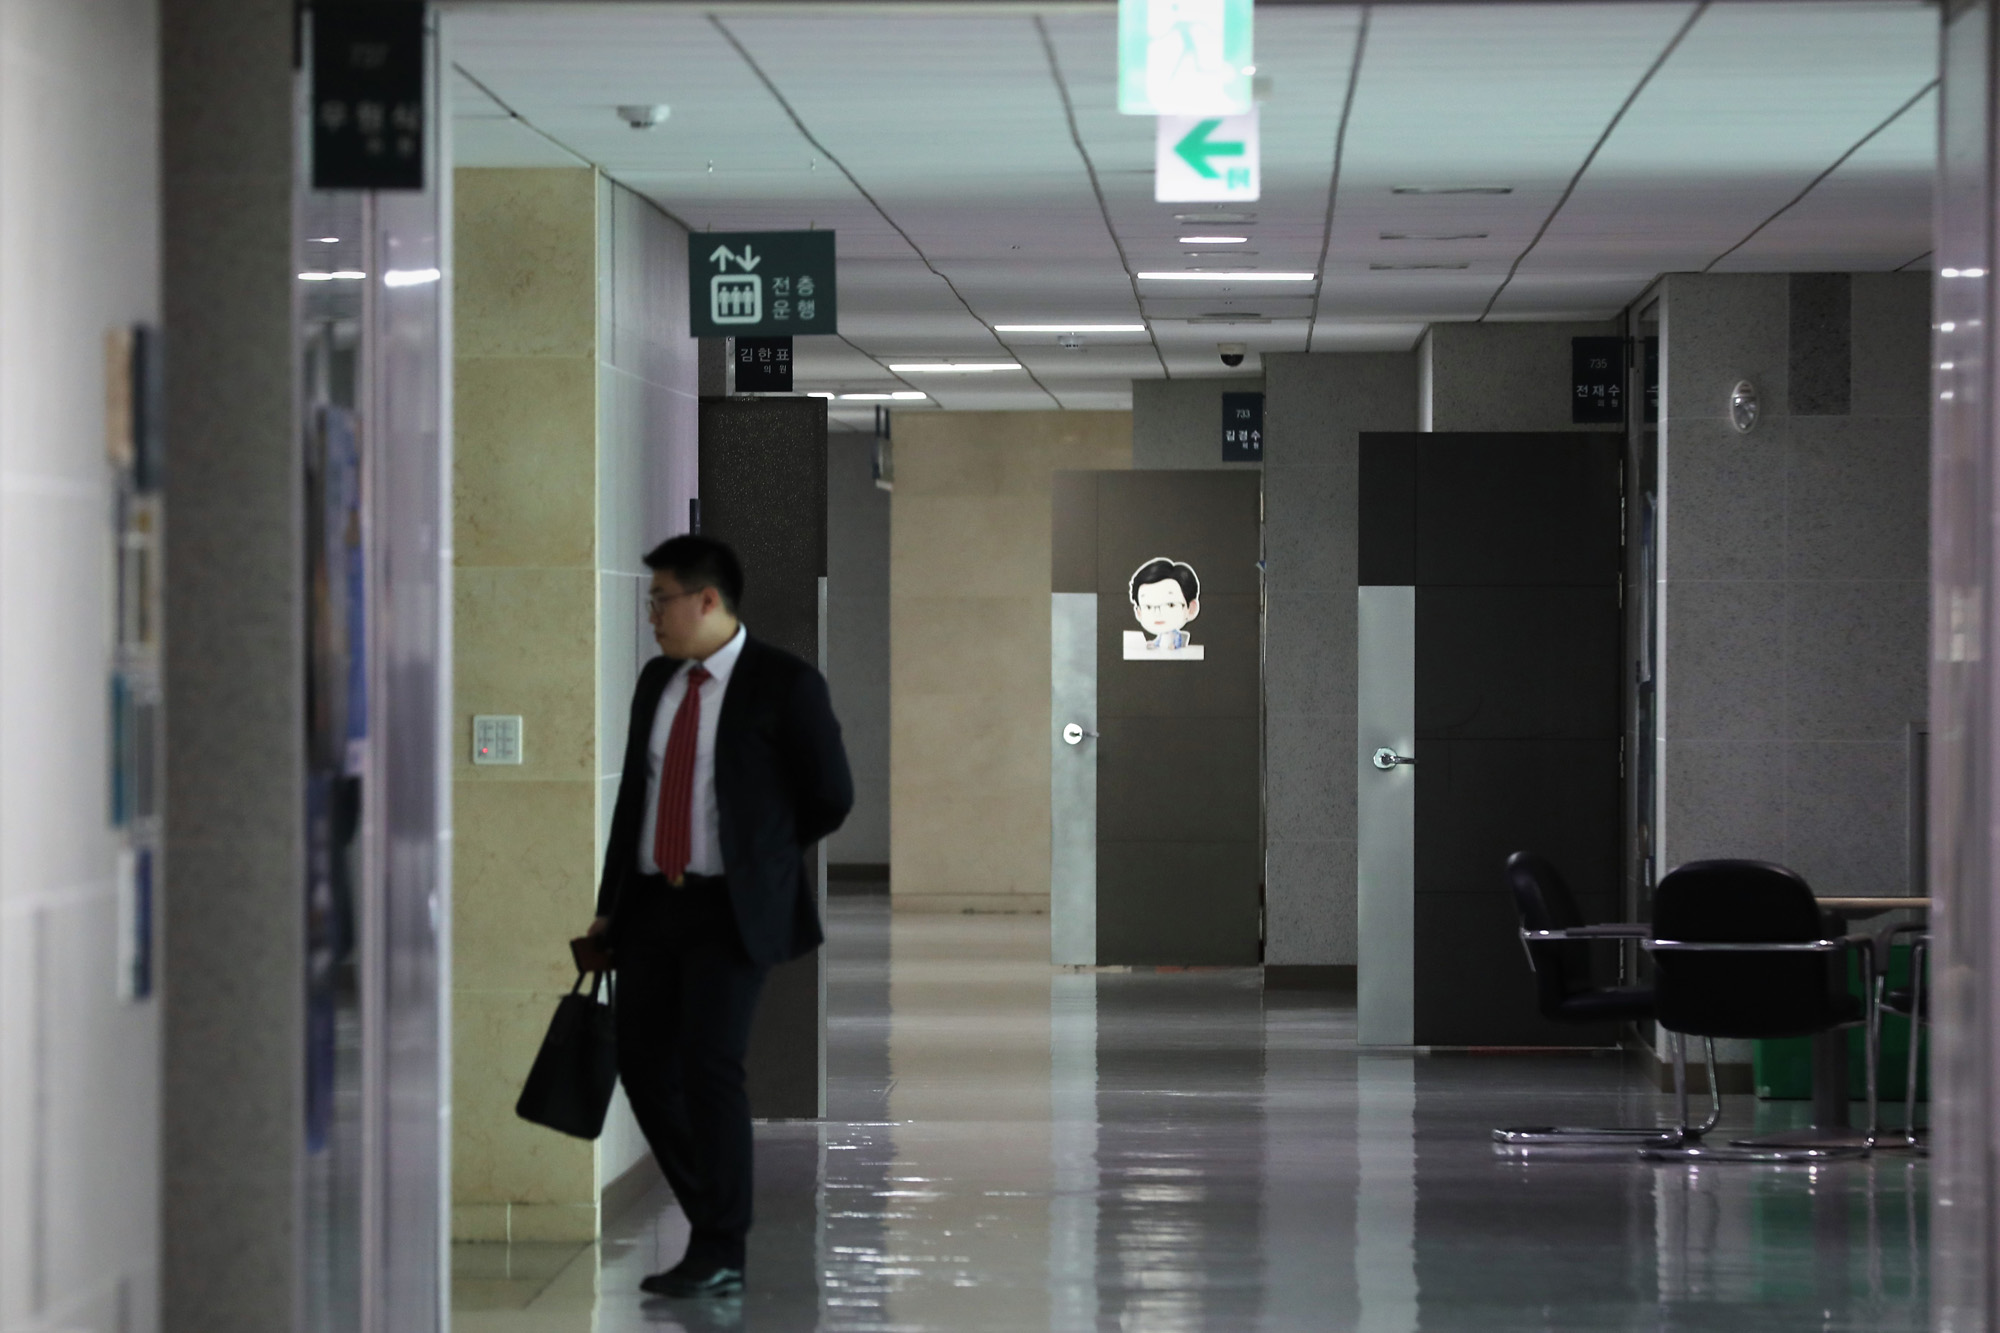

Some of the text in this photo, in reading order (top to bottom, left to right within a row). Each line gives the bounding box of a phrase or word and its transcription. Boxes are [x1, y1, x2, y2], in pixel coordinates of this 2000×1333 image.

[772, 275, 815, 297] 전층
[772, 299, 815, 320] 운행
[740, 347, 790, 363] 김한표
[763, 364, 787, 375] 의원
[1589, 358, 1608, 369] 735
[1576, 384, 1620, 398] 전재수
[1236, 408, 1251, 419] 733
[1226, 429, 1261, 442] 김경수
